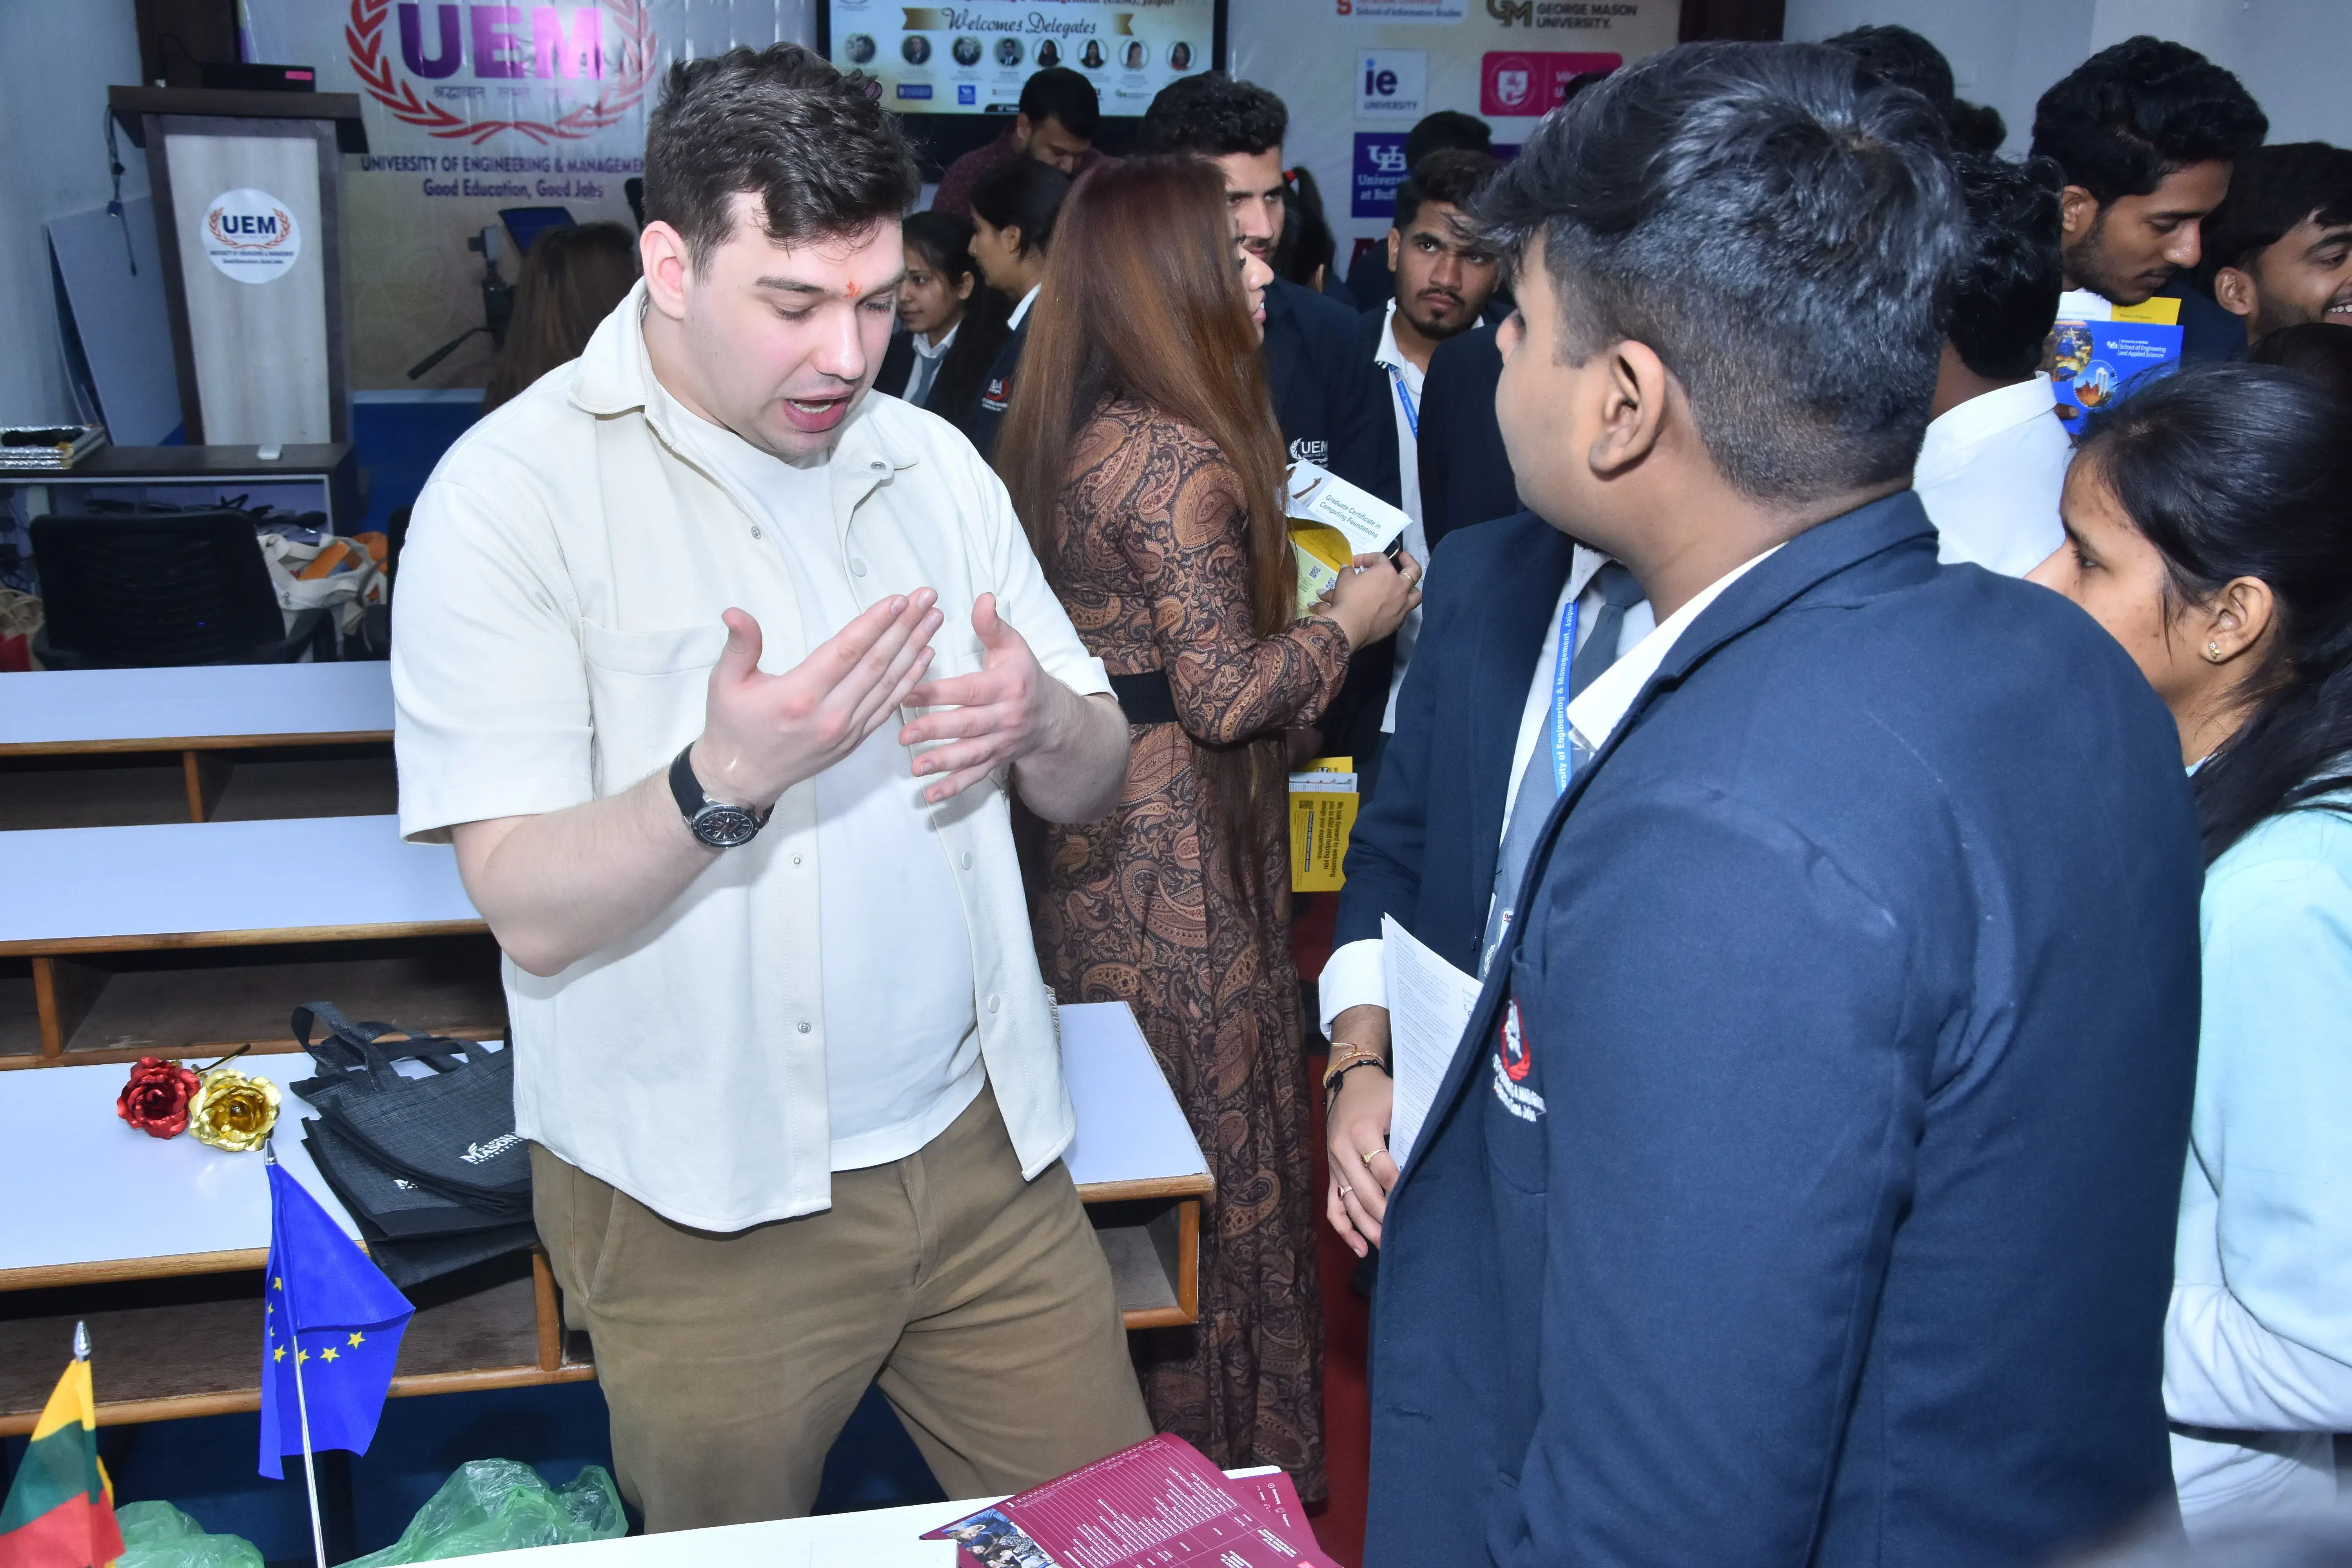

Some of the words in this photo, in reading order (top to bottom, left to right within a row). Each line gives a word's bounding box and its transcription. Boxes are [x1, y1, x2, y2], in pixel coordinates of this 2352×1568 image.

[1537, 3, 1588, 15] GEORGE
[1591, 4, 1638, 15] MASON
[942, 7, 1022, 31] Welcomes
[1025, 11, 1096, 38] Delegates
[399, 3, 604, 78] UEM
[1365, 58, 1397, 96] ie
[1365, 101, 1418, 110] UNIVERSITY
[361, 156, 436, 171] UNIVERSITY
[441, 156, 459, 171] OF
[463, 156, 550, 172] ENGINEERING
[555, 157, 564, 173] &
[424, 178, 459, 196] Good
[463, 178, 532, 200] Education,
[536, 179, 571, 197] Good
[575, 179, 604, 198] Jobs
[222, 215, 276, 234] UEM
[1326, 495, 1349, 511] Graduate
[1349, 508, 1376, 526] Certificate
[1320, 502, 1348, 521] Computing
[1347, 517, 1379, 538] Foundations
[1557, 629, 1571, 686] Management,
[1557, 696, 1565, 748] Engineering
[1559, 750, 1565, 761] of
[1334, 821, 1342, 841] forward
[1316, 829, 1324, 860] experience.
[1323, 839, 1332, 858] helping
[1329, 848, 1339, 878] welcoming
[459, 1135, 519, 1163] MASON
[473, 1138, 526, 1164] UNIVERSITY
[1168, 1466, 1179, 1476] Systems
[1191, 1472, 1200, 1481] Studies
[1165, 1479, 1184, 1495] Communication
[1178, 1475, 1192, 1488] Information
[1193, 1481, 1207, 1494] Challenges
[1200, 1480, 1209, 1489] Russian
[1168, 1488, 1184, 1503] Management
[1194, 1490, 1210, 1504] Management
[1211, 1490, 1223, 1501] European
[1216, 1488, 1226, 1496] Studies
[1153, 1497, 1169, 1511] Management
[1166, 1494, 1179, 1505] Economics
[1183, 1495, 1196, 1506] Integrated
[1192, 1495, 1205, 1506] Economics
[1222, 1500, 1232, 1508] Eastern
[1225, 1495, 1237, 1506] European
[1098, 1499, 1117, 1517] Entrepreneurship
[1156, 1506, 1168, 1518] Economics
[1172, 1506, 1182, 1515] Banking
[1181, 1506, 1191, 1516] Business
[1184, 1502, 1196, 1513] Resources
[1198, 1507, 1210, 1518] Marketing
[1204, 1506, 1216, 1516] Strategic
[1210, 1503, 1221, 1513] Strategic
[1122, 1513, 1140, 1530] Communication
[1142, 1517, 1152, 1526] Finance
[1169, 1511, 1178, 1519] Process
[1184, 1517, 1194, 1526] Finance
[1099, 1515, 1119, 1534] Entrepreneurship
[1113, 1521, 1126, 1532] Chemistry
[1119, 1518, 1138, 1535] Communication
[1151, 1517, 1163, 1528] Marketing
[1161, 1519, 1178, 1534] Management
[1168, 1517, 1183, 1531] Quantitative
[1178, 1519, 1189, 1528] Business
[1077, 1526, 1092, 1541] Management
[1082, 1523, 1096, 1536] Investments
[1093, 1525, 1105, 1537] Innovation
[1147, 1528, 1161, 1541] Accounting
[1153, 1527, 1167, 1538] Economics
[1258, 1529, 1273, 1541] RELATIONS
[1263, 1529, 1276, 1539] SCIENCE
[1098, 1538, 1107, 1547] Finance
[1120, 1535, 1138, 1551] Nanochemistry
[1125, 1532, 1144, 1548] Pharmaceutical
[1137, 1535, 1150, 1546] Innovative
[1139, 1530, 1155, 1543] International
[1073, 1538, 1093, 1557] Entrepreneurship
[1107, 1539, 1127, 1556] Entrepreneurship
[1122, 1544, 1132, 1553] Geology
[1267, 1541, 1281, 1552] INSTITUTE
[1273, 1541, 1294, 1557] INTERNATIONAL
[1275, 1538, 1290, 1549] POLITICAL
[1073, 1546, 1083, 1556] Business
[1090, 1546, 1102, 1557] Marketing
[1099, 1548, 1115, 1561] International
[1107, 1546, 1121, 1559] Sustainable
[1082, 1556, 1098, 1568] nternational
[1229, 1550, 1252, 1568] ADMINISTRATION
[1230, 1555, 1244, 1566] BUSINESS
